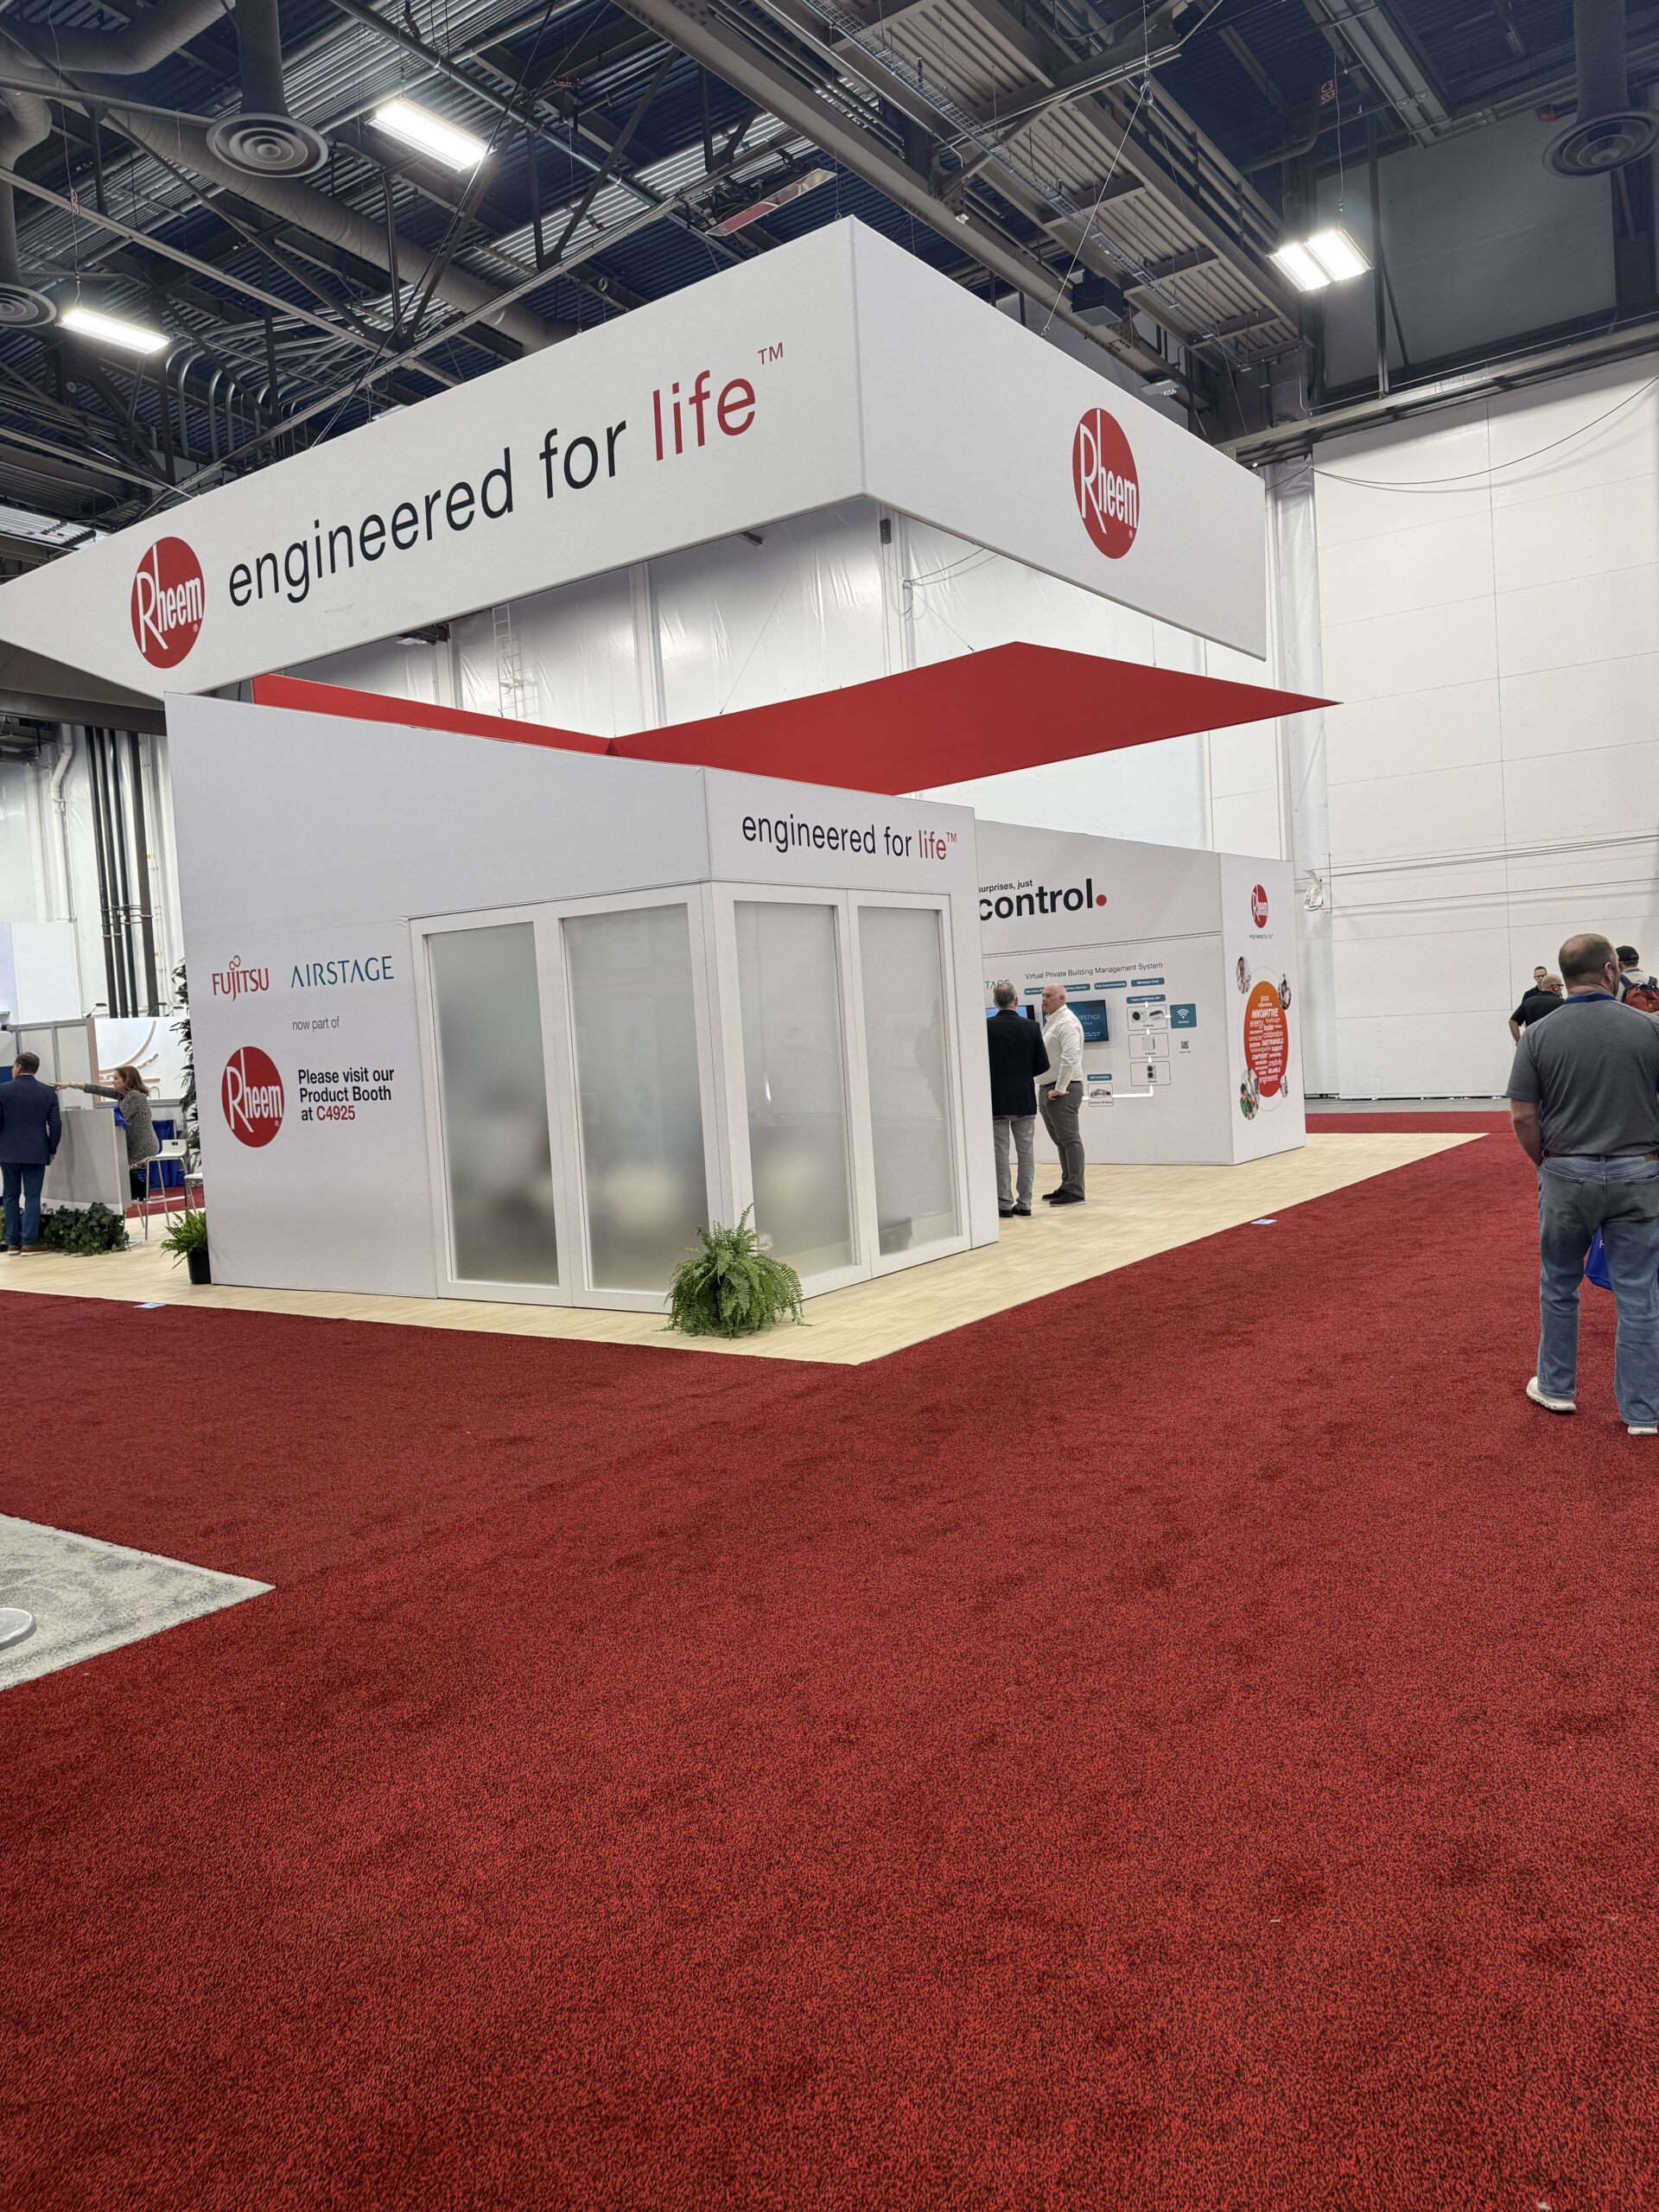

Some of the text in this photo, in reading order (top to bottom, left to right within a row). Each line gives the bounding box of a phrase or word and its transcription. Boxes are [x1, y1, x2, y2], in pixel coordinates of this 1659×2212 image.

[1080, 409, 1136, 535] Rheem
[229, 447, 514, 607] engineered
[539, 420, 626, 499] for
[136, 543, 203, 653] Rheem
[741, 813, 876, 855] engineered
[883, 825, 912, 857] for
[979, 878, 1108, 921] control.
[1017, 879, 1033, 890] just
[211, 955, 395, 1002] FUJITSU AIRSTAGE
[1025, 962, 1163, 980] Virtual Private Building Management System
[292, 1015, 340, 1032] now part of
[1251, 1008, 1279, 1019] INNOVATIVE
[226, 1048, 283, 1133] Rheem
[297, 1067, 395, 1084] Please visit our
[299, 1084, 392, 1103] Product Booth
[301, 1105, 356, 1121] at C4925
